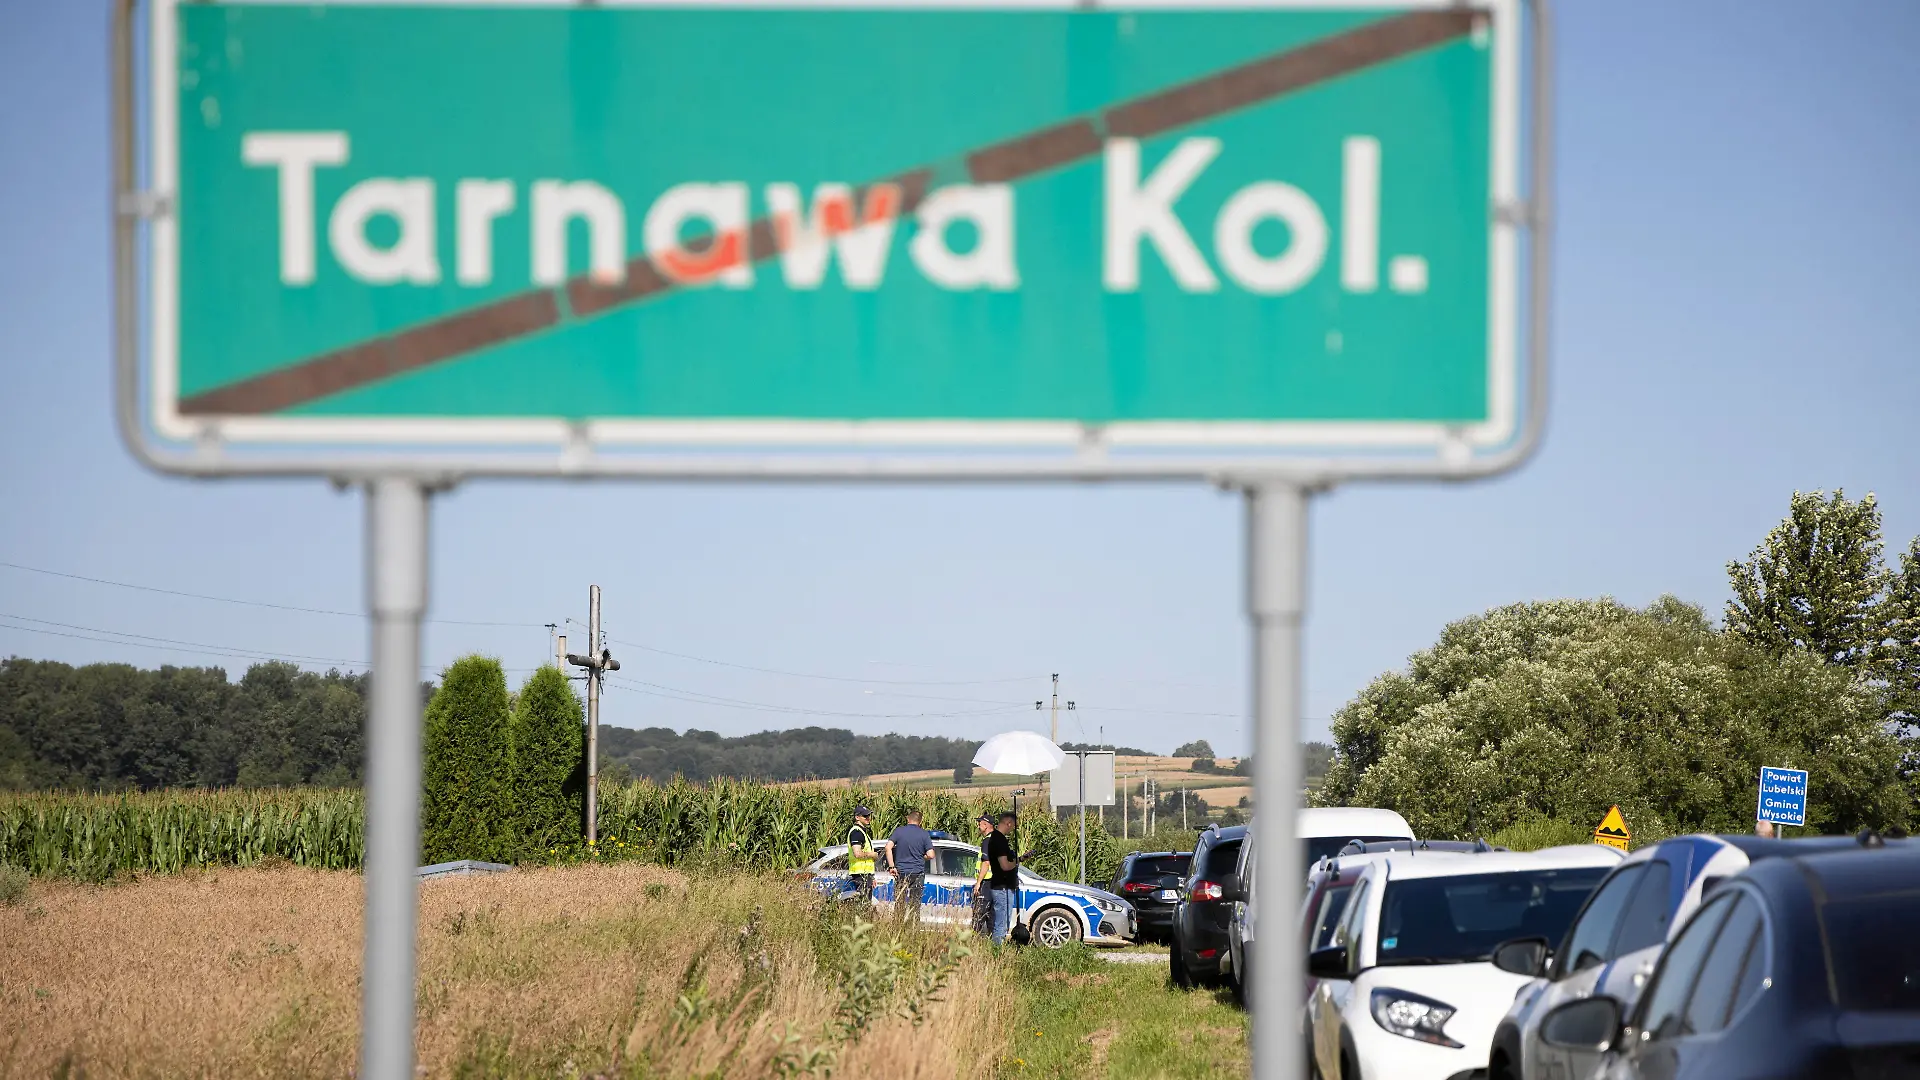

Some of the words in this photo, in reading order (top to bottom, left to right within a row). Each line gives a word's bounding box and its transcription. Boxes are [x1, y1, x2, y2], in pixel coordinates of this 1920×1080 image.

[241, 131, 1019, 290] Tarnawa
[1102, 135, 1430, 295] Kol.
[1767, 771, 1801, 783] Powiat
[1762, 783, 1804, 796] Lubelski
[1765, 798, 1799, 810] Gmina
[1761, 808, 1803, 821] Wysokie
